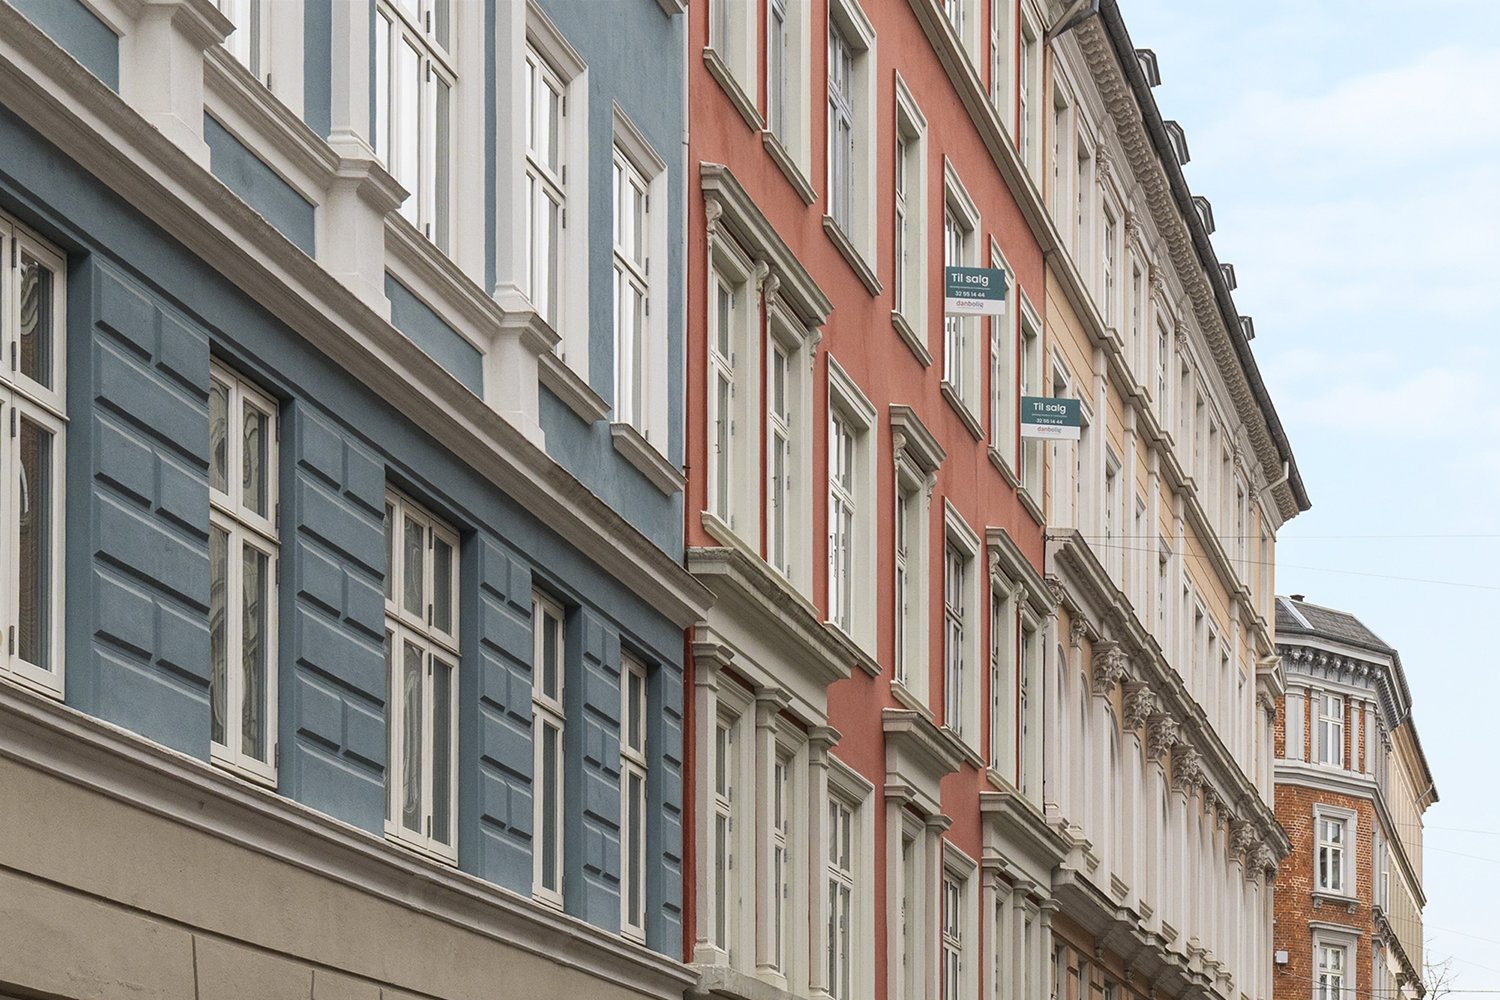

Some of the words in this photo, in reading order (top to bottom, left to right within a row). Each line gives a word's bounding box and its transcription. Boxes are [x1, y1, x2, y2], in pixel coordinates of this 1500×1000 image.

[952, 272, 963, 282] Til
[966, 274, 988, 286] salg
[956, 300, 984, 308] danbolig
[1033, 402, 1044, 410] Til
[1046, 404, 1066, 414] salg
